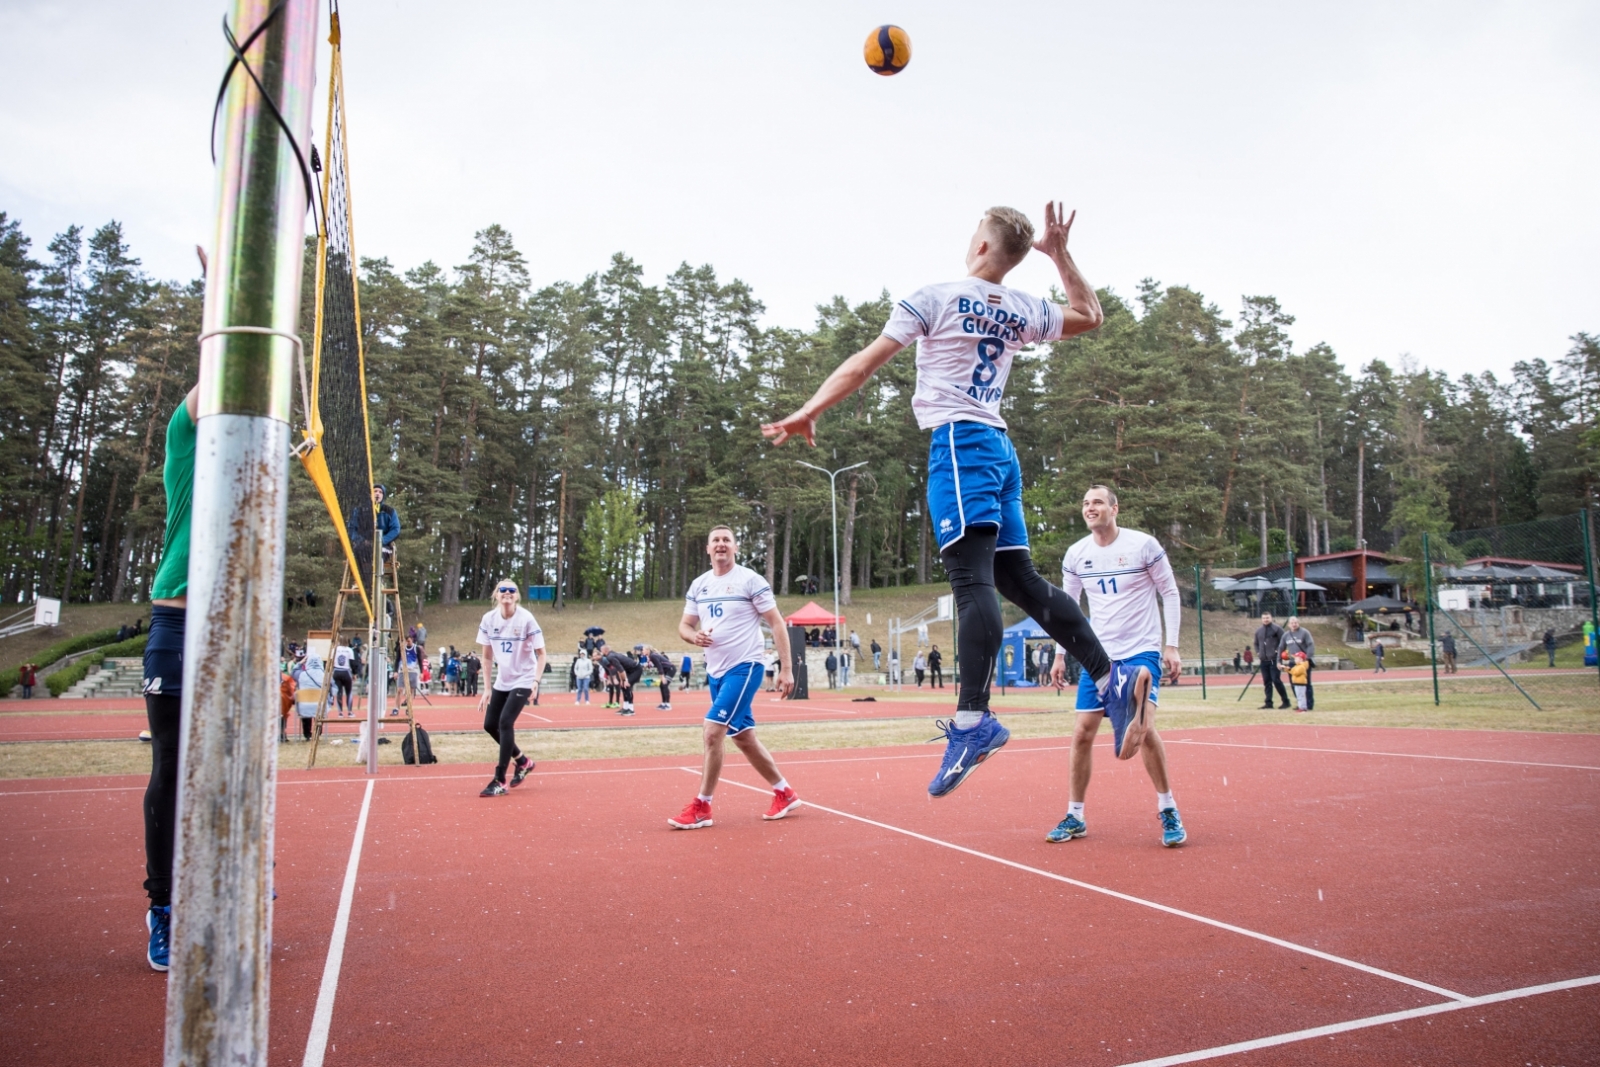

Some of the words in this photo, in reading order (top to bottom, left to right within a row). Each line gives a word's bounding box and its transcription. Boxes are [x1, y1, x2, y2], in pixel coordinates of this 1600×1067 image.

[958, 297, 1027, 333] BORDER
[962, 316, 1019, 342] GUARD
[972, 337, 1005, 386] 8
[1096, 577, 1118, 595] 11
[707, 602, 723, 618] 16
[500, 641, 513, 653] 12
